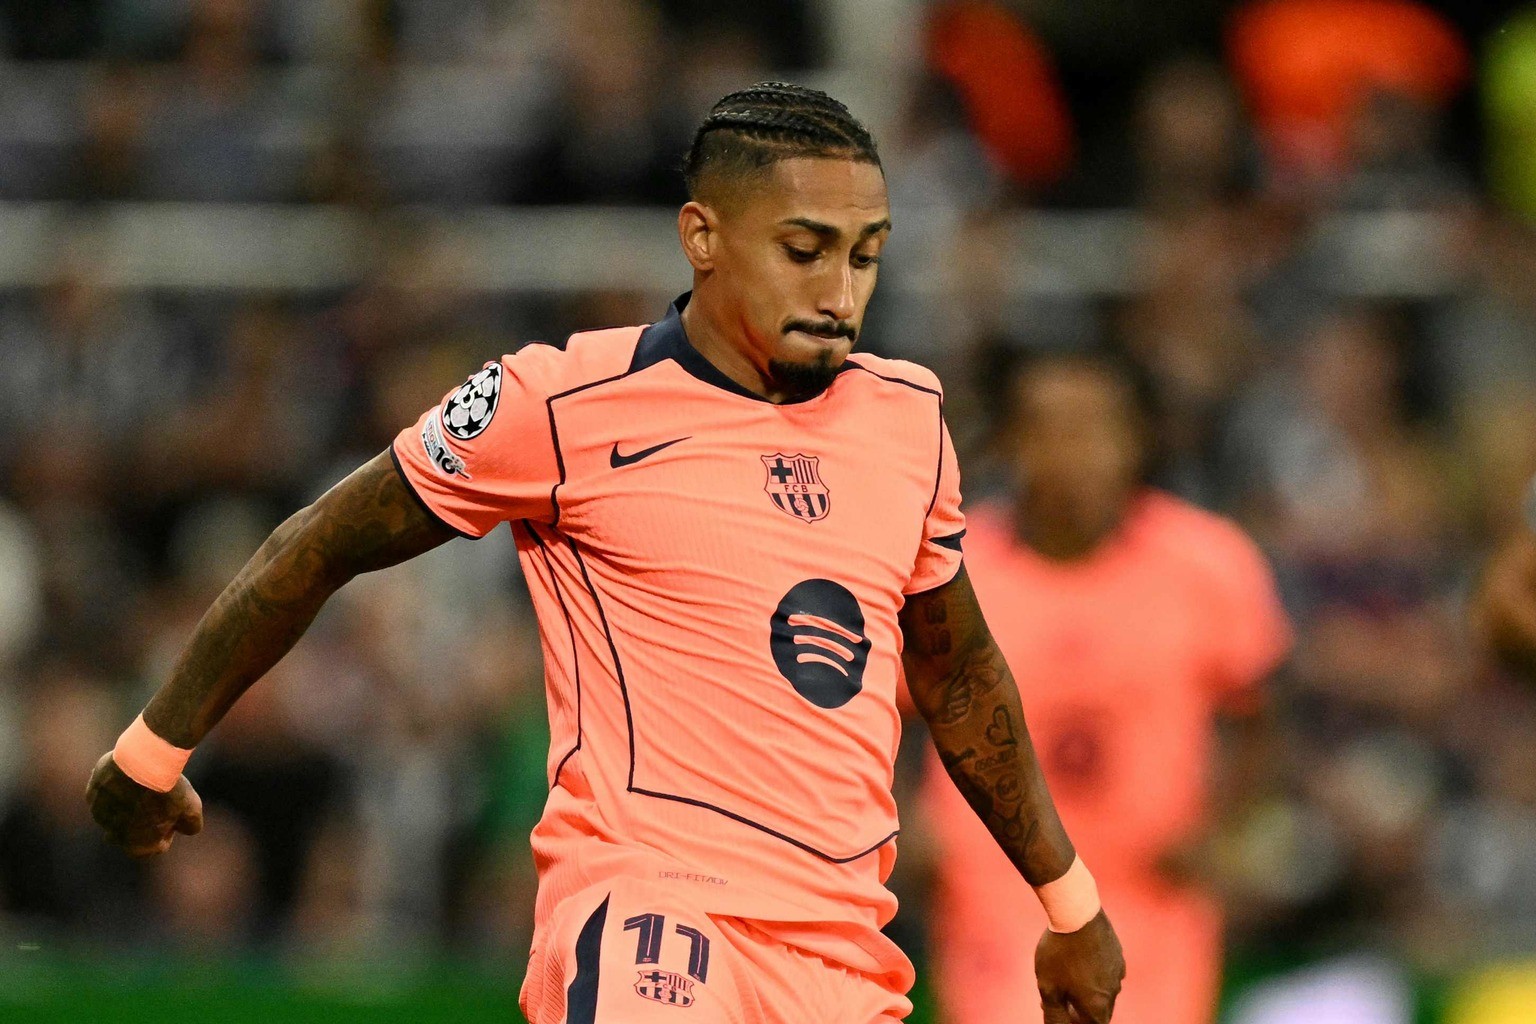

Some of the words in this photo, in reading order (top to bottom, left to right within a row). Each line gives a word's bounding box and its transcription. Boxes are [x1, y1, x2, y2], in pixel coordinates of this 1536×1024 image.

[460, 382, 484, 409] 5
[784, 484, 808, 493] FCB
[623, 913, 710, 984] 11
